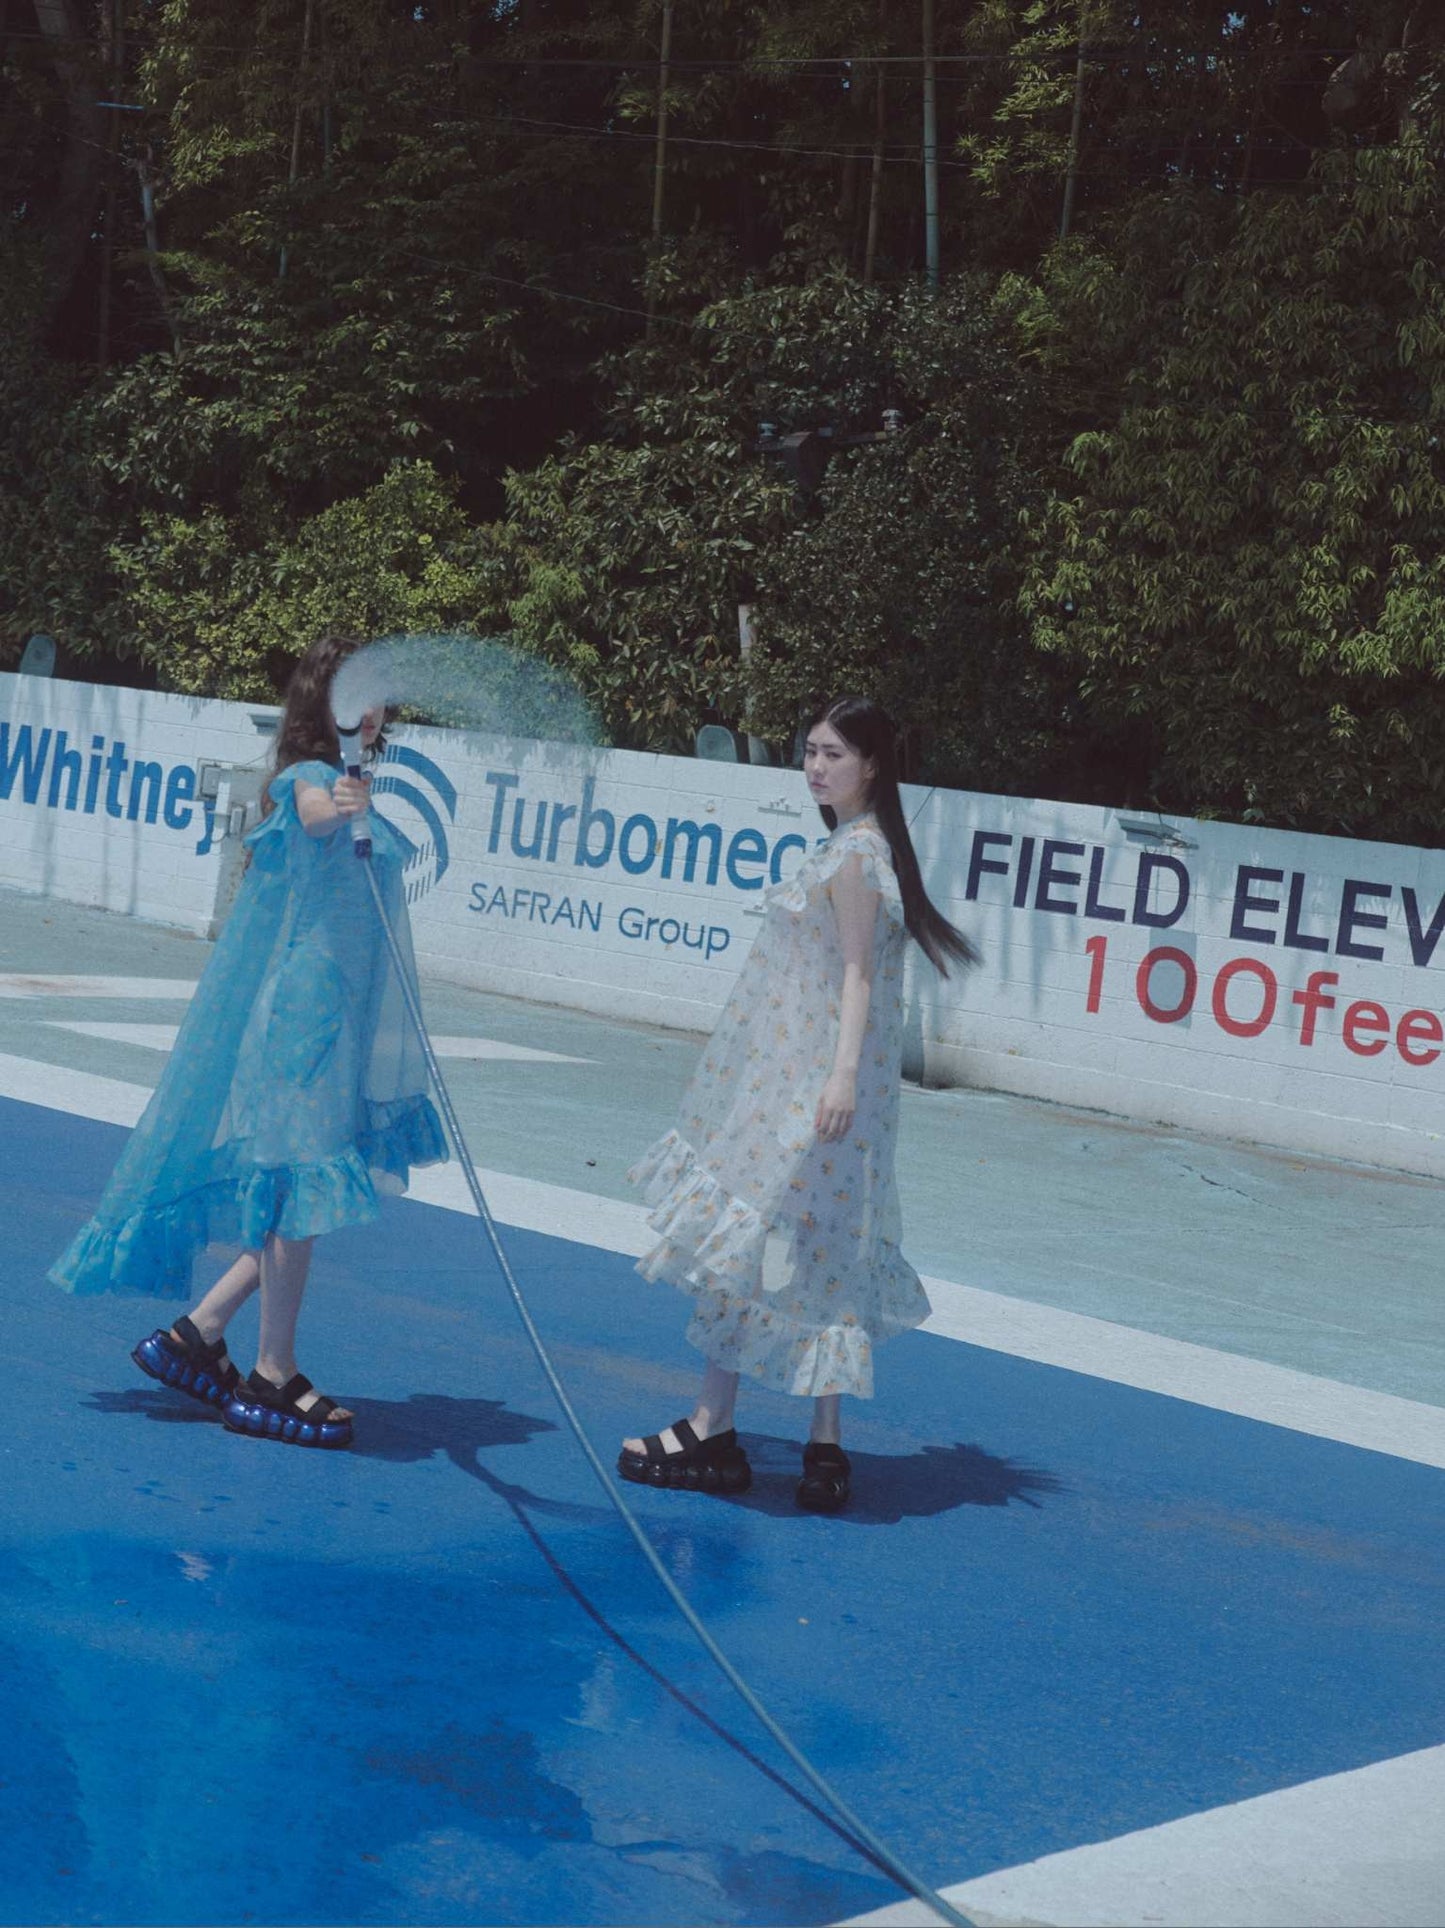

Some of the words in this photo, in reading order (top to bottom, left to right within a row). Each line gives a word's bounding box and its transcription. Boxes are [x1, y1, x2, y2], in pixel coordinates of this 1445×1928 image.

[486, 772, 828, 890] Turbomec
[468, 881, 603, 933] SAFRAN
[617, 906, 731, 960] Group
[965, 830, 1191, 929] FIELD
[1229, 864, 1445, 967] ELEV
